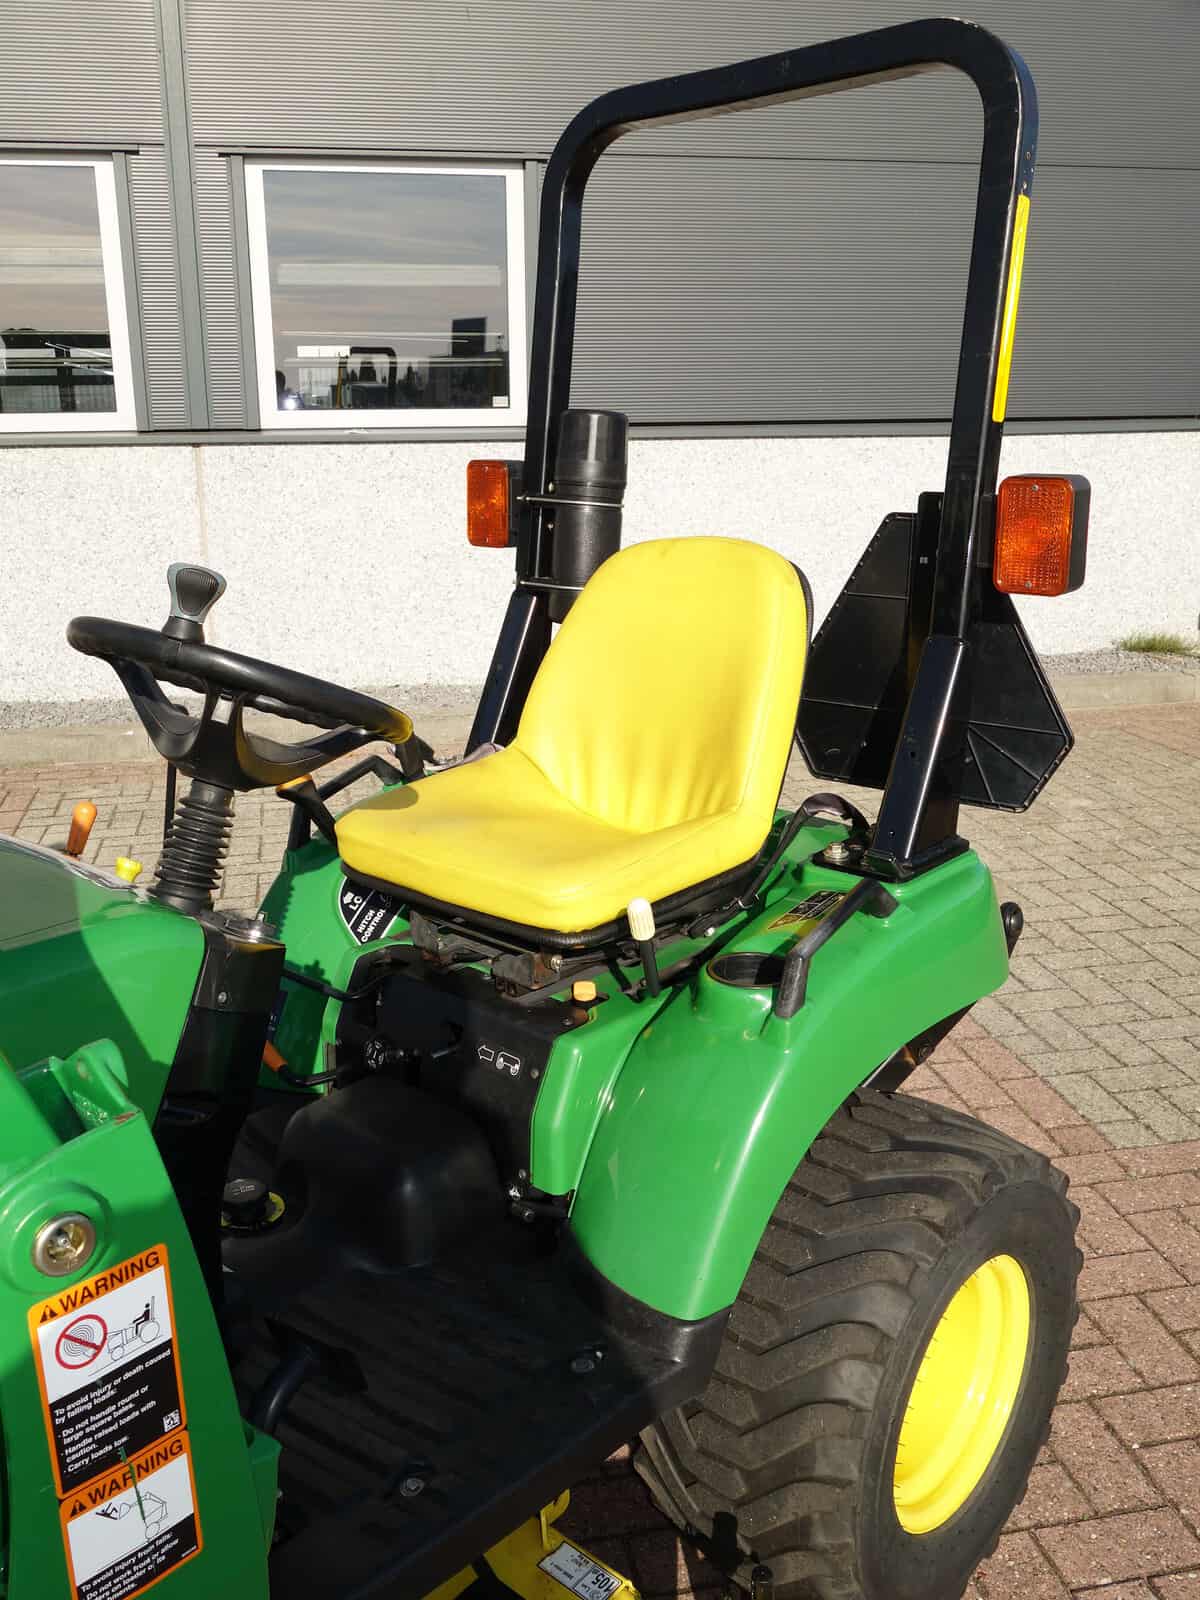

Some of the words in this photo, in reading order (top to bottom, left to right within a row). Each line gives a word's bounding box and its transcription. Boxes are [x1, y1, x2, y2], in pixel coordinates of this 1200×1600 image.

[357, 909, 376, 934] HITCH
[361, 909, 386, 942] CONTROL
[59, 1251, 160, 1313] WARNING
[54, 1408, 65, 1417] To
[66, 1394, 89, 1411] avoid
[89, 1383, 113, 1401] injury
[113, 1376, 122, 1386] or
[122, 1364, 145, 1381] death
[144, 1348, 171, 1368] caused
[55, 1415, 65, 1425] by
[67, 1401, 93, 1419] falling
[62, 1426, 75, 1438] Do
[75, 1418, 89, 1433] not
[90, 1404, 117, 1422] handle
[117, 1391, 140, 1408] round
[140, 1385, 149, 1394] or
[65, 1437, 93, 1456] Handle
[94, 1422, 119, 1440] raised
[119, 1410, 140, 1426] loads
[140, 1400, 157, 1413] with
[63, 1431, 84, 1446] large
[85, 1415, 113, 1434] square
[67, 1456, 90, 1473] Carry
[91, 1445, 113, 1460] loads
[81, 1583, 92, 1592] To
[92, 1569, 114, 1586] avoid
[114, 1555, 137, 1573] injury
[99, 1581, 112, 1594] not
[113, 1569, 133, 1584] work
[133, 1556, 151, 1572] front
[151, 1551, 160, 1560] or
[111, 1583, 121, 1593] on
[122, 1568, 146, 1586] loader
[591, 1572, 614, 1593] 105
